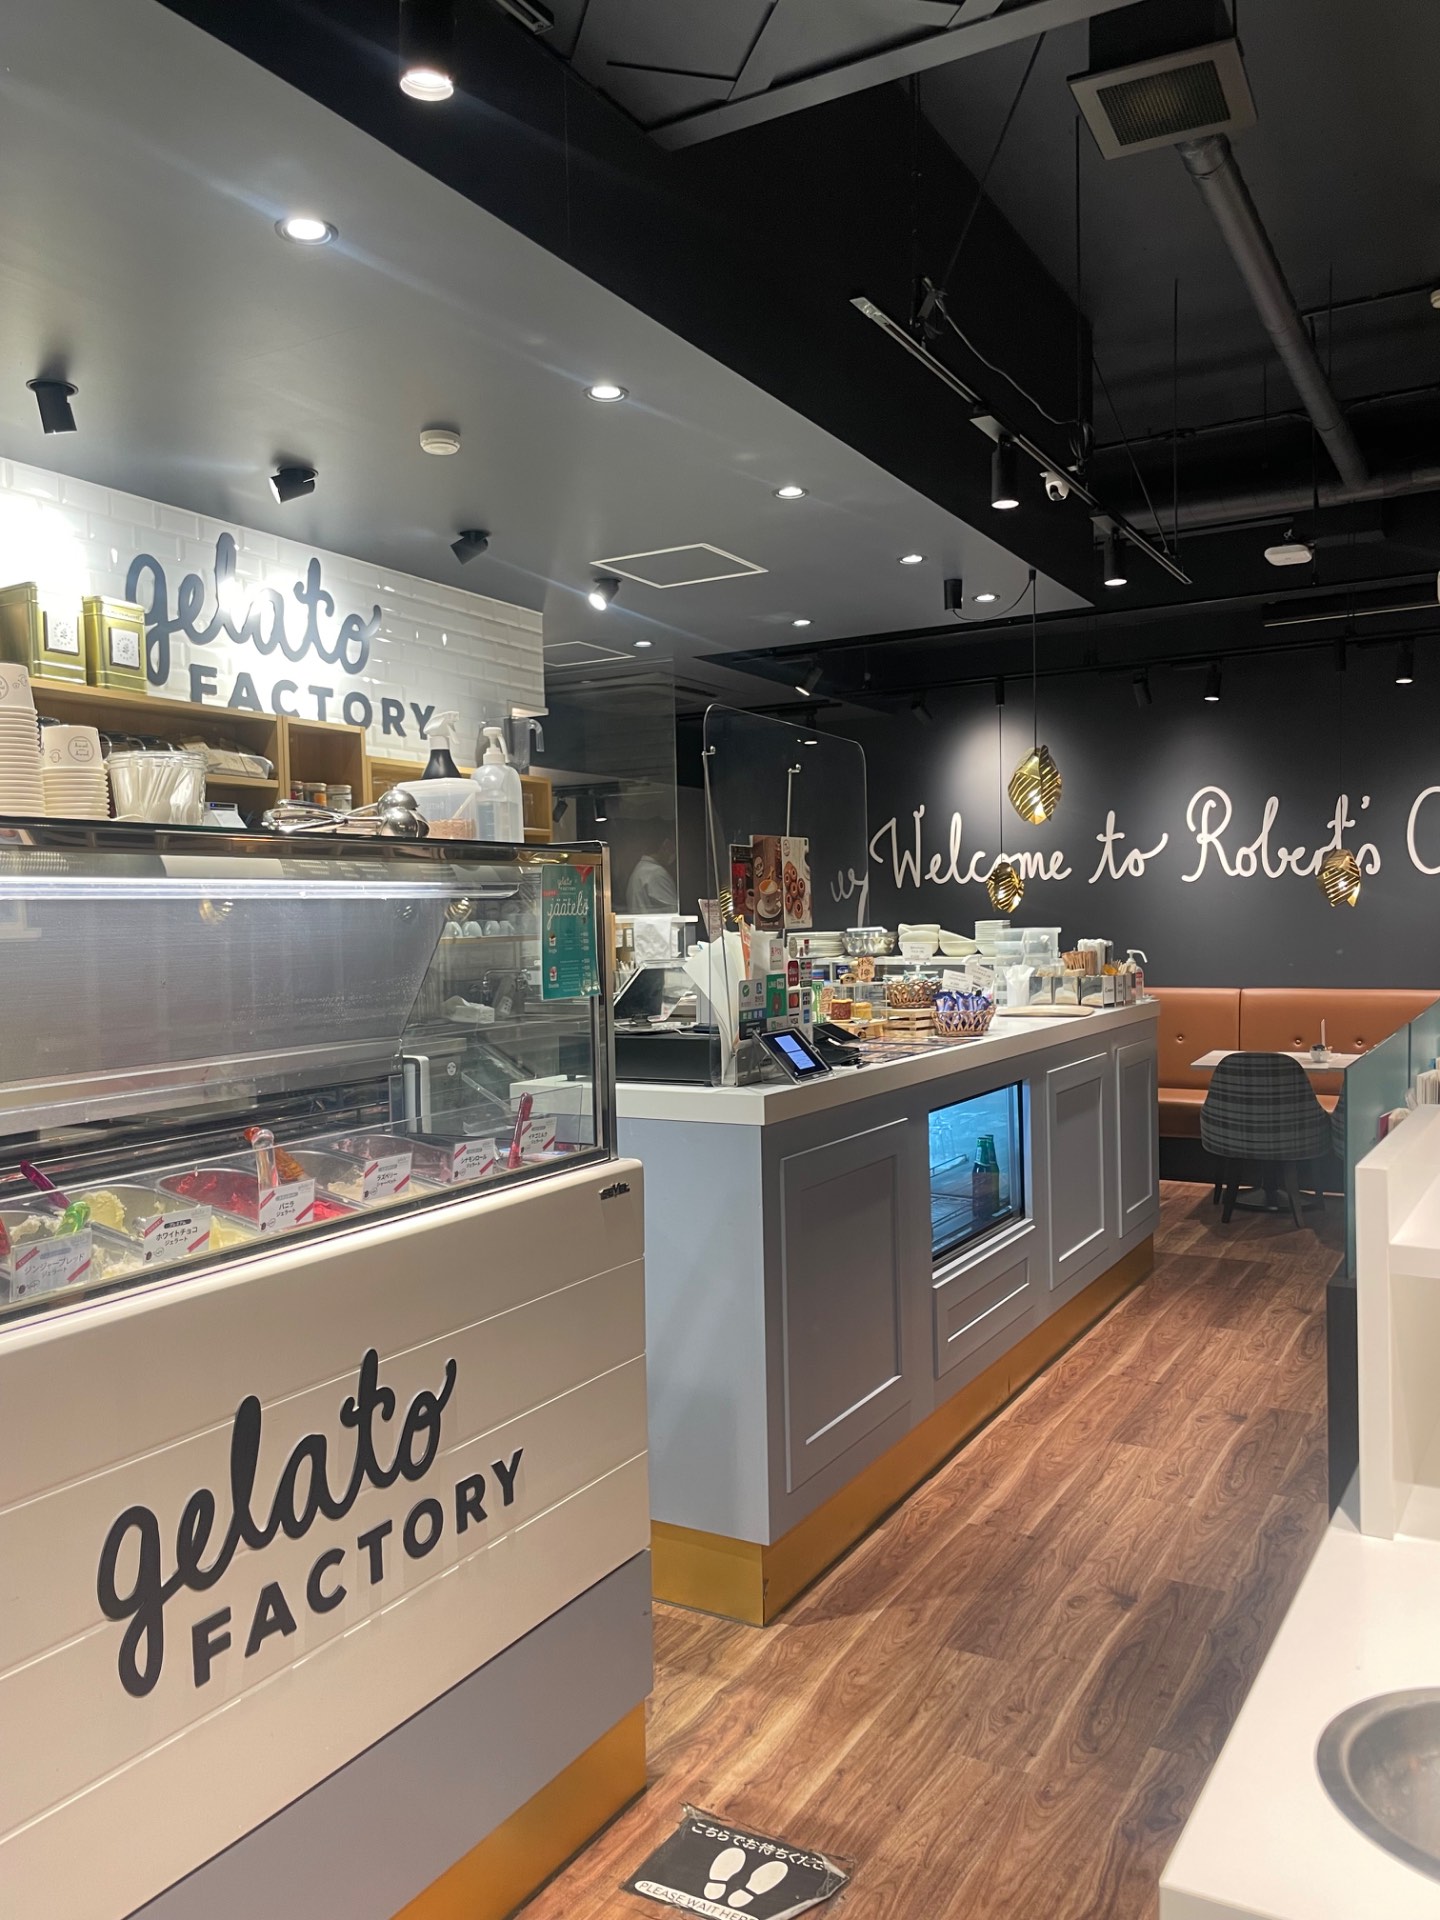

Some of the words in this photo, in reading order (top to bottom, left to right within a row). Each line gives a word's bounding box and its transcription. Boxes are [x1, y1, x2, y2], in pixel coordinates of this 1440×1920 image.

[125, 531, 382, 686] gelato
[189, 663, 436, 740] FACTORY
[1088, 809, 1169, 884] to
[155, 1226, 198, 1242] ホワイトチョコ
[97, 1348, 457, 1697] gelato
[191, 1448, 524, 1688] FACTORY
[639, 1881, 686, 1905] PLEASE
[687, 1897, 720, 1914] WAIT
[719, 1909, 757, 1920] HER
